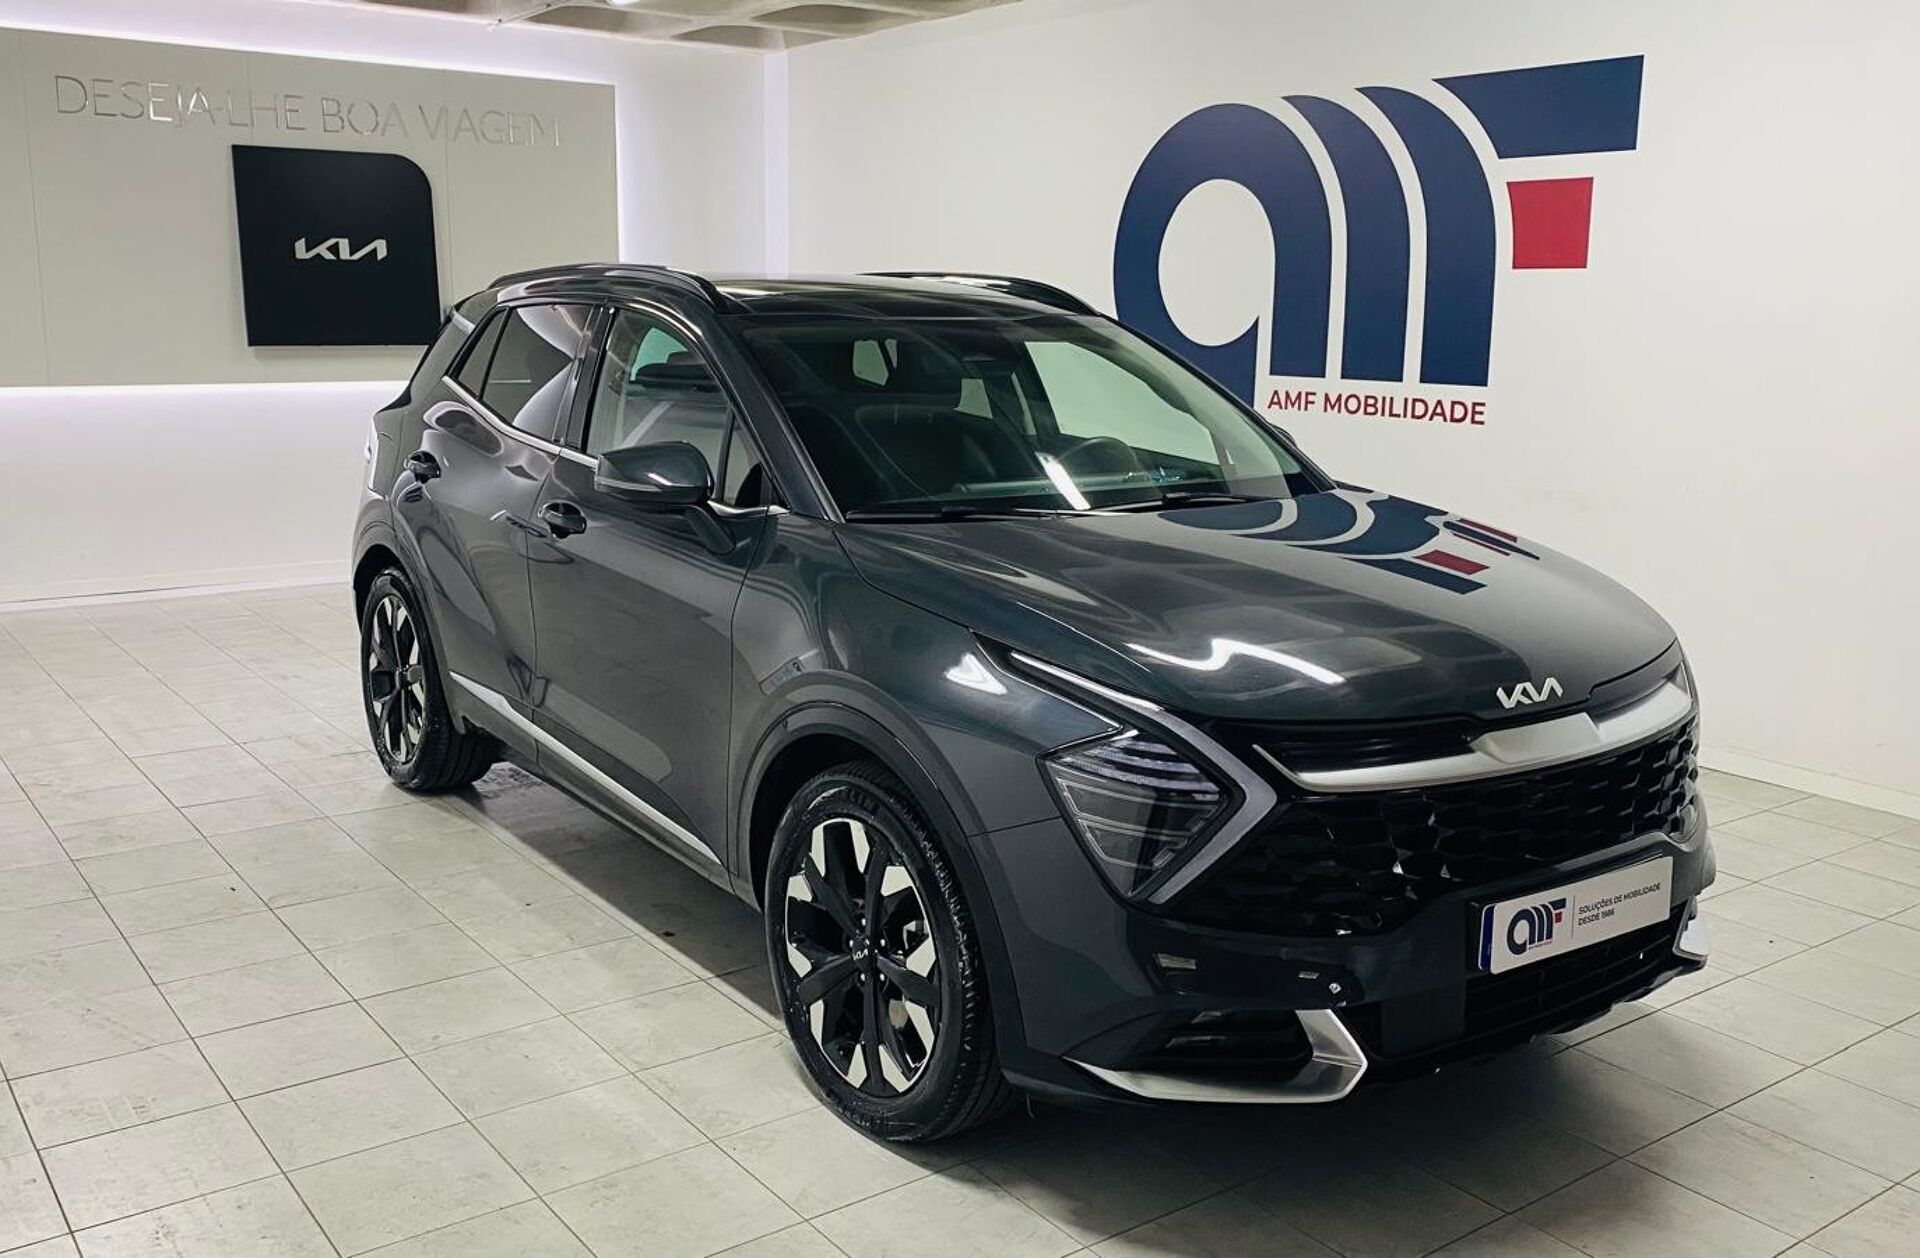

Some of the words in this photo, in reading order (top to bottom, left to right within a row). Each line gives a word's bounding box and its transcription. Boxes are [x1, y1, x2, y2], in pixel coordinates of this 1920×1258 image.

[320, 98, 409, 138] BOA
[418, 104, 560, 147] VIAGEM
[294, 238, 388, 261] KIA
[1267, 389, 1317, 412] AMF
[1323, 392, 1487, 425] MOBILIDADE
[1496, 677, 1563, 709] KIA
[1613, 894, 1623, 904] DE
[1578, 912, 1601, 926] DESDE
